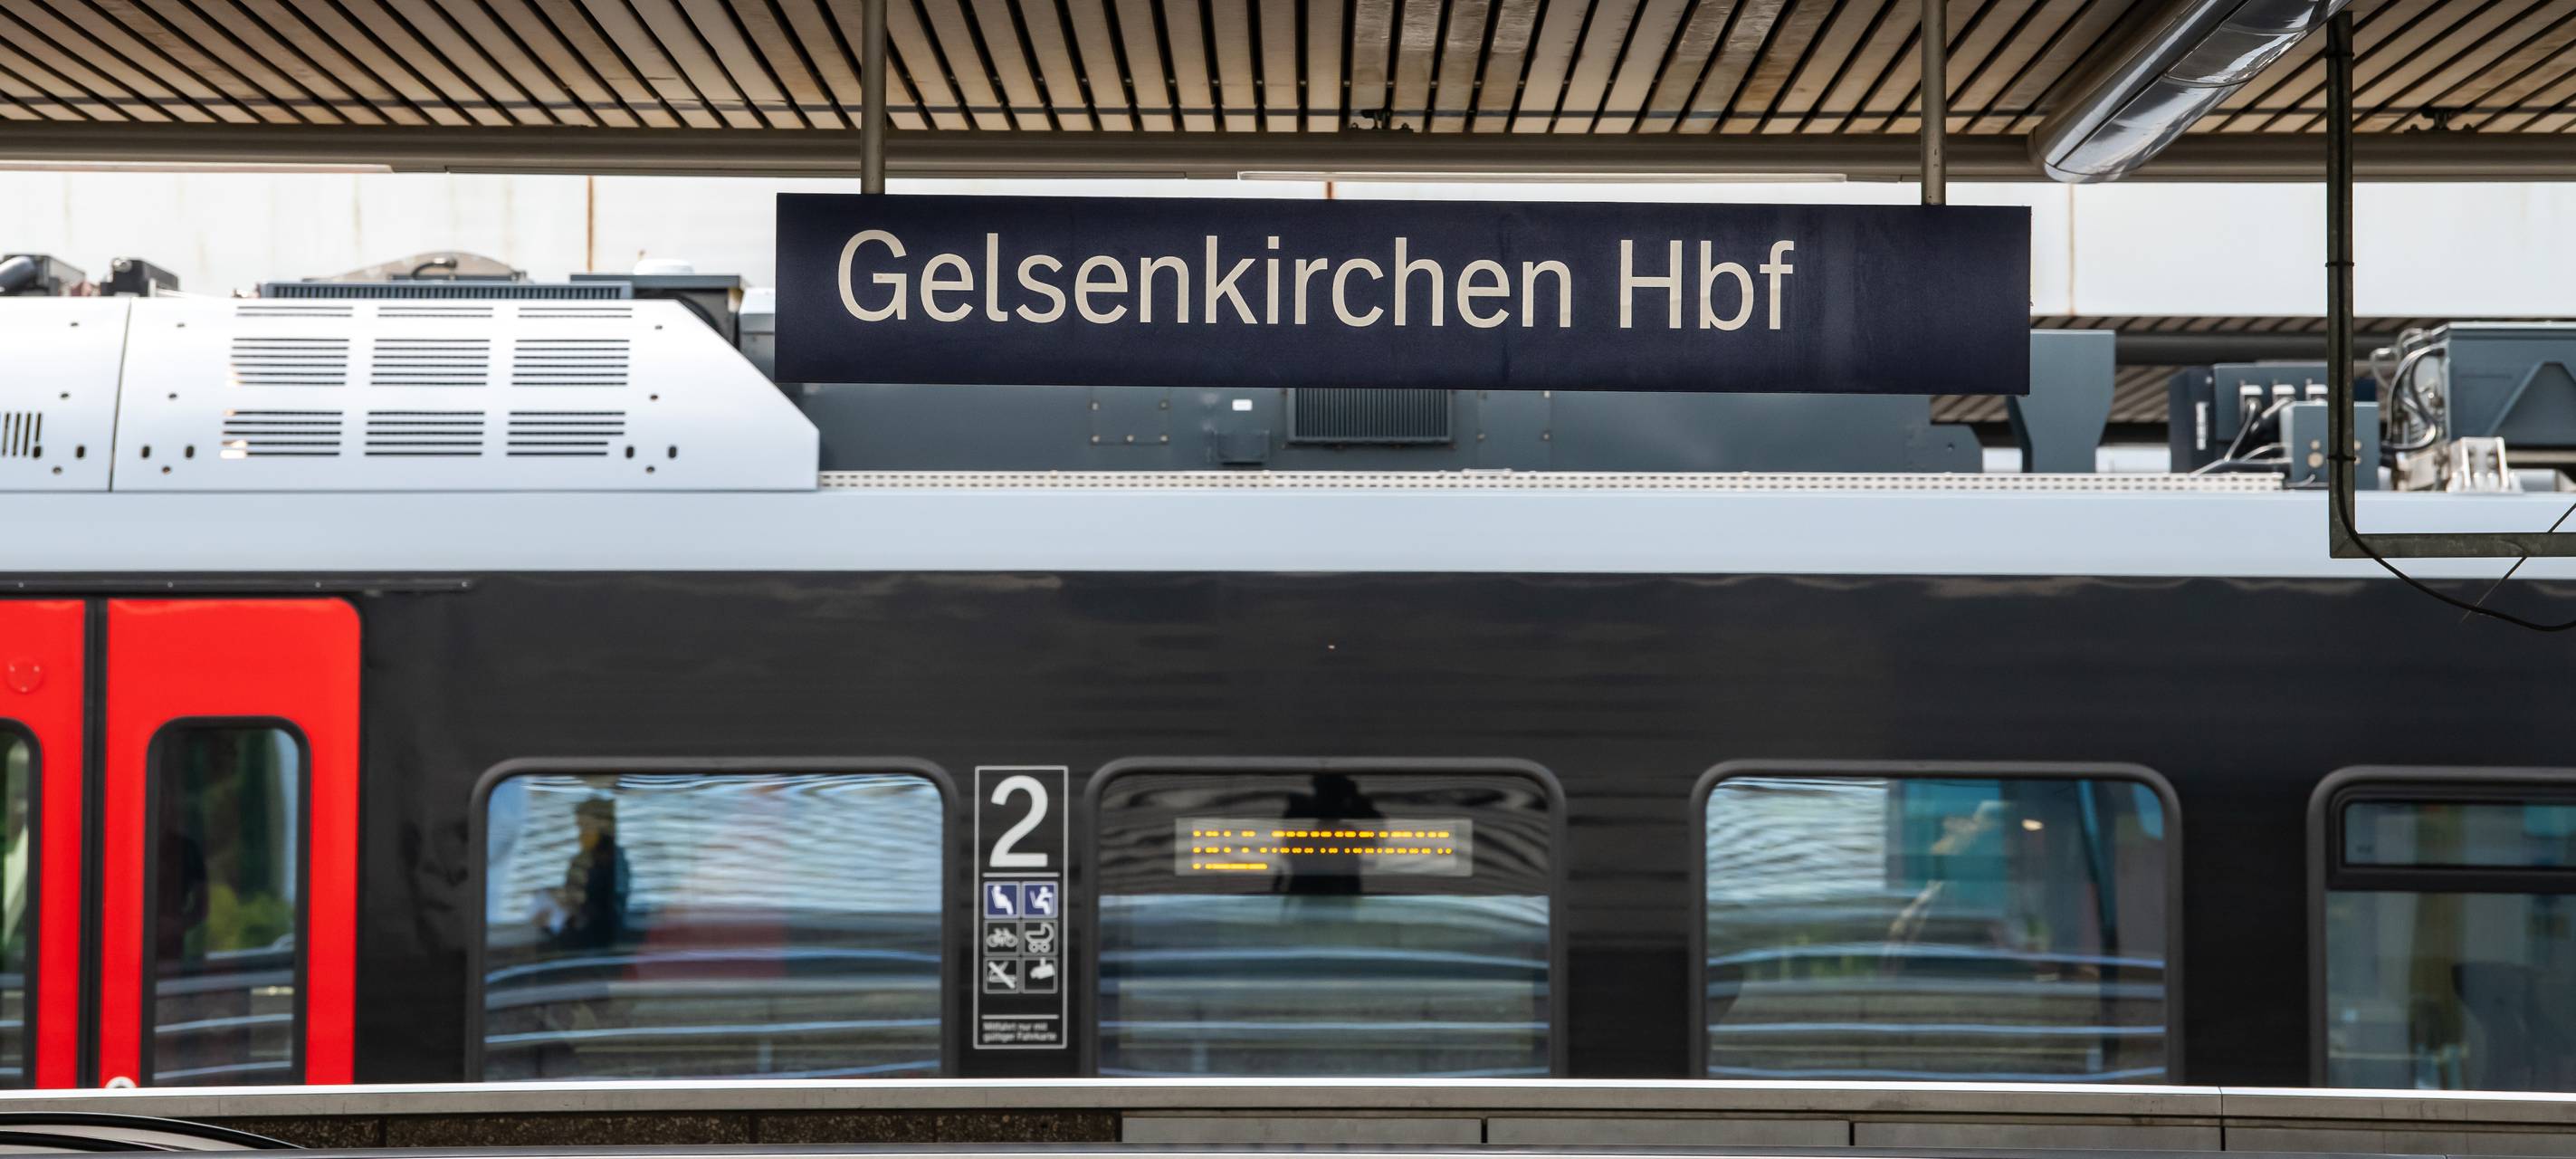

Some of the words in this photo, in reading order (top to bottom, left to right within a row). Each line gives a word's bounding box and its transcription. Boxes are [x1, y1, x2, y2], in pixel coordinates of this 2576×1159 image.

[838, 230, 1572, 328] Gelsenkirchen
[1620, 239, 1794, 331] Hbf
[989, 775, 1048, 867] 2
